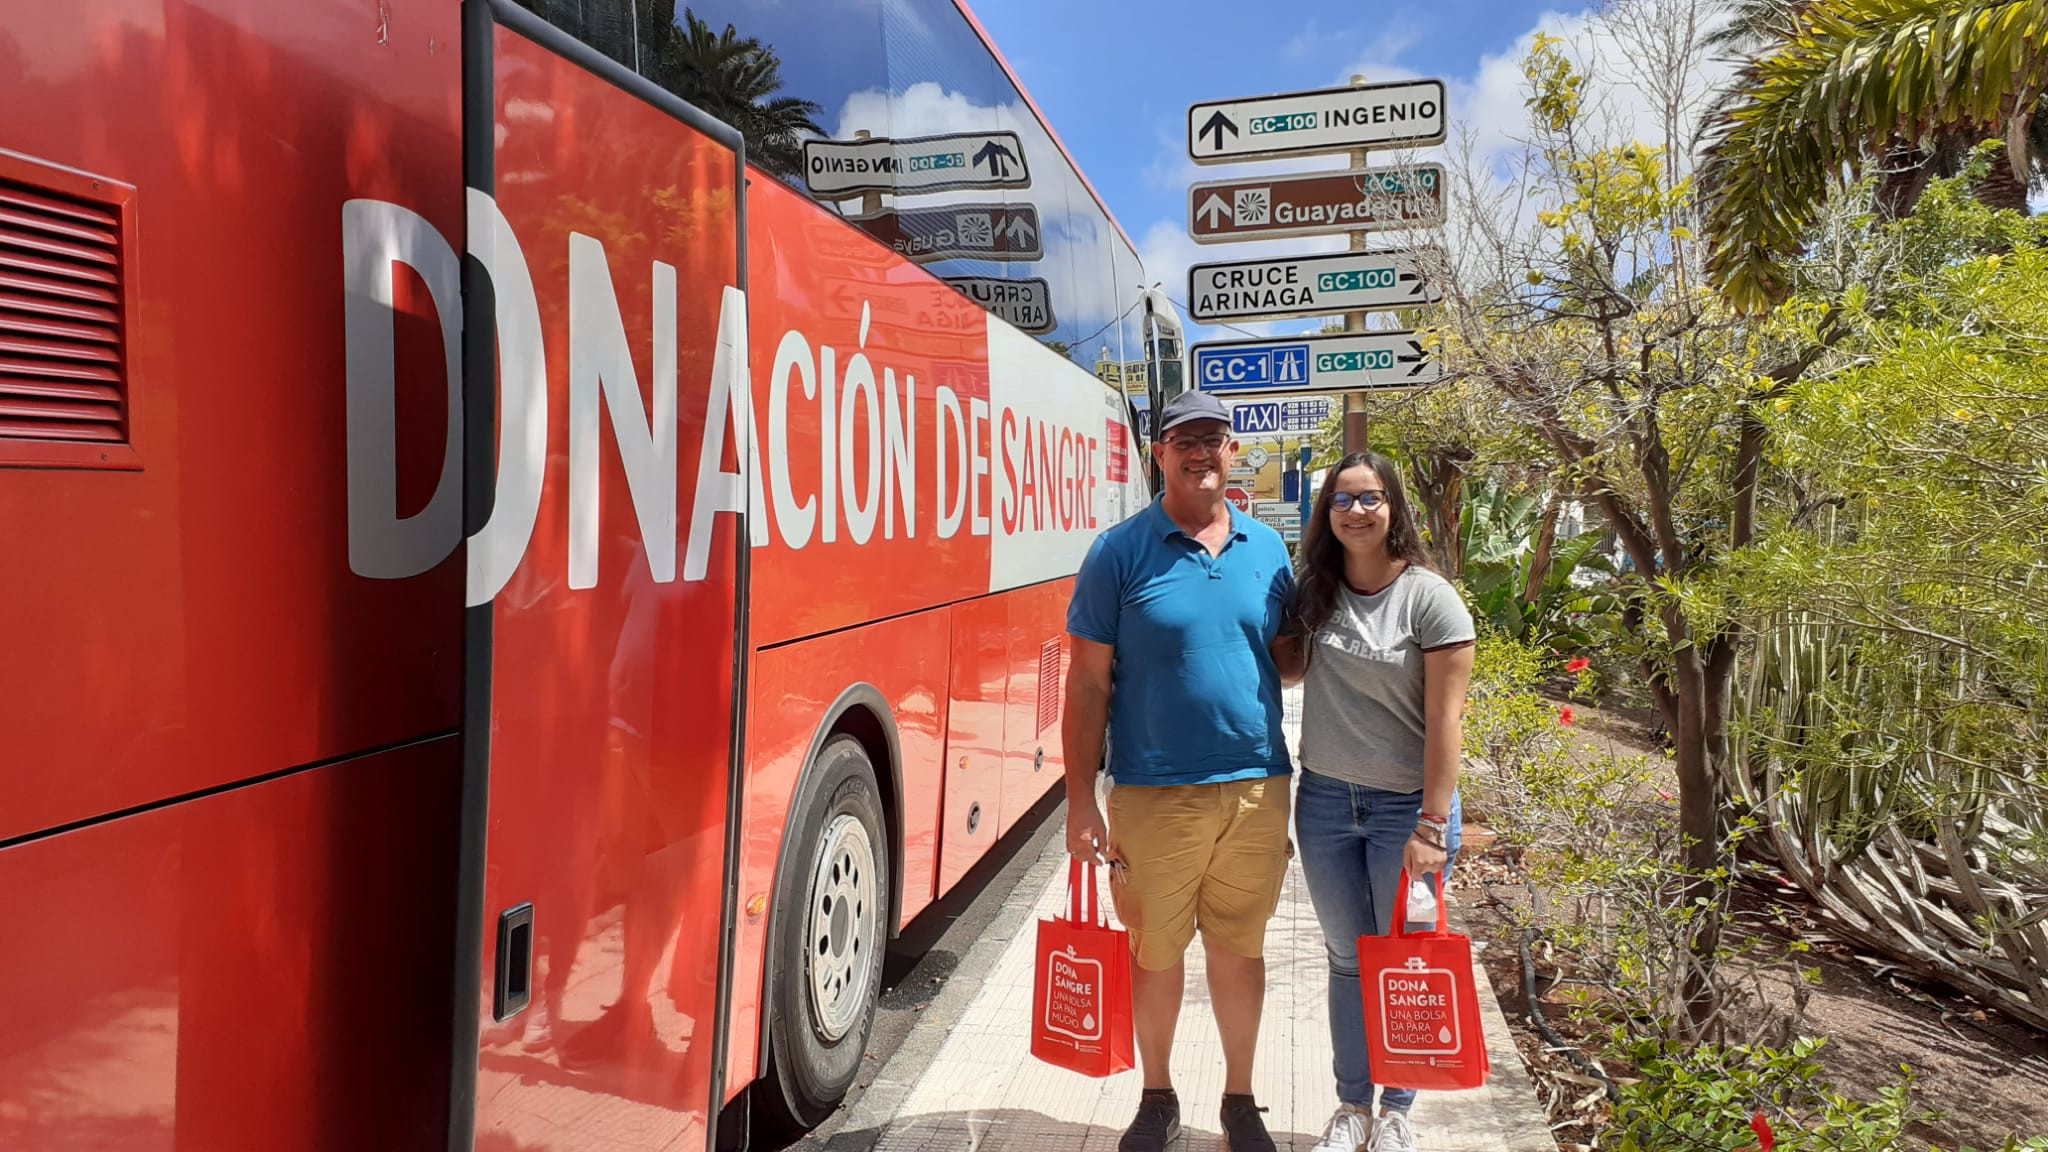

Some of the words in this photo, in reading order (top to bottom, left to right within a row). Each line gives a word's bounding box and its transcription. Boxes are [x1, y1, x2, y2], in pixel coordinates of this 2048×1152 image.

[1250, 113, 1316, 133] GC-100
[1324, 100, 1437, 128] INGENIO
[1212, 265, 1298, 289] CRUCE
[1319, 270, 1394, 291] GC-100
[1198, 285, 1314, 313] ARINAGA
[1204, 356, 1269, 382] GC-1
[1318, 351, 1392, 372] GC-100
[1236, 405, 1277, 431] TAXI
[936, 385, 991, 539] DE
[1001, 406, 1097, 536] SANGRE
[1055, 975, 1092, 995] SANGRE
[1388, 979, 1429, 992] DONA
[1389, 994, 1446, 1006] SANGRE
[1389, 1010, 1412, 1020] UNA
[1414, 1010, 1447, 1021] BOLSA
[1391, 1021, 1404, 1031] DA
[1406, 1022, 1431, 1032] PARA
[1391, 1034, 1434, 1044] MUCHO
